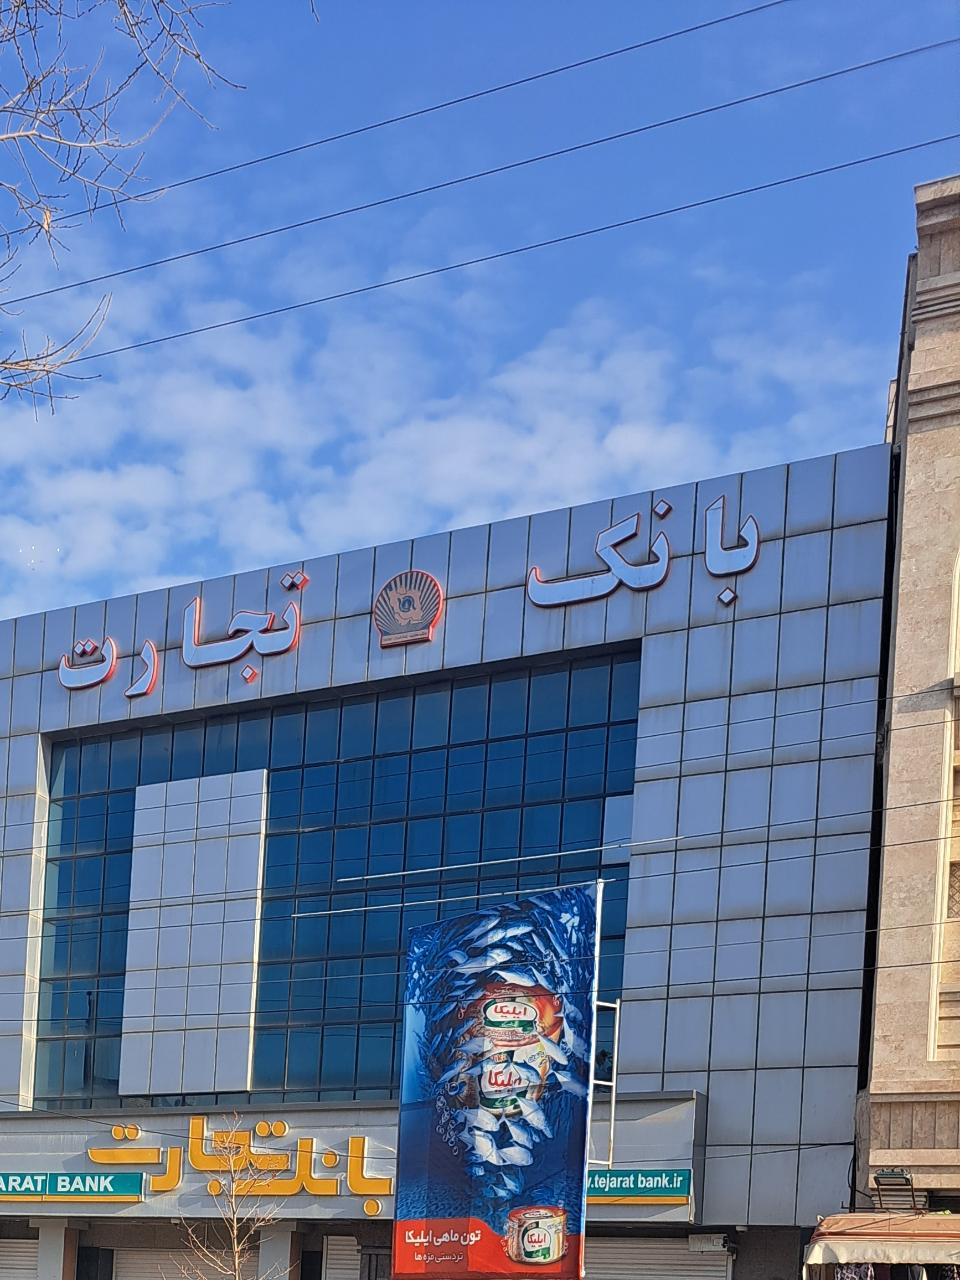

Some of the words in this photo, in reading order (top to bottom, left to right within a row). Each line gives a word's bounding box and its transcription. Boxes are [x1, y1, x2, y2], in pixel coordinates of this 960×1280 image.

[526, 495, 761, 608] بانک
[57, 570, 311, 699] تجارت
[493, 1004, 528, 1019] ایلیکا
[87, 1115, 291, 1196] تجارت
[57, 1175, 115, 1192] BANK
[233, 1136, 395, 1217] بانک
[638, 1173, 683, 1188] bank.ir
[405, 1229, 433, 1247] ایلیکا
[433, 1229, 460, 1246] ماهی
[460, 1230, 482, 1246] تون
